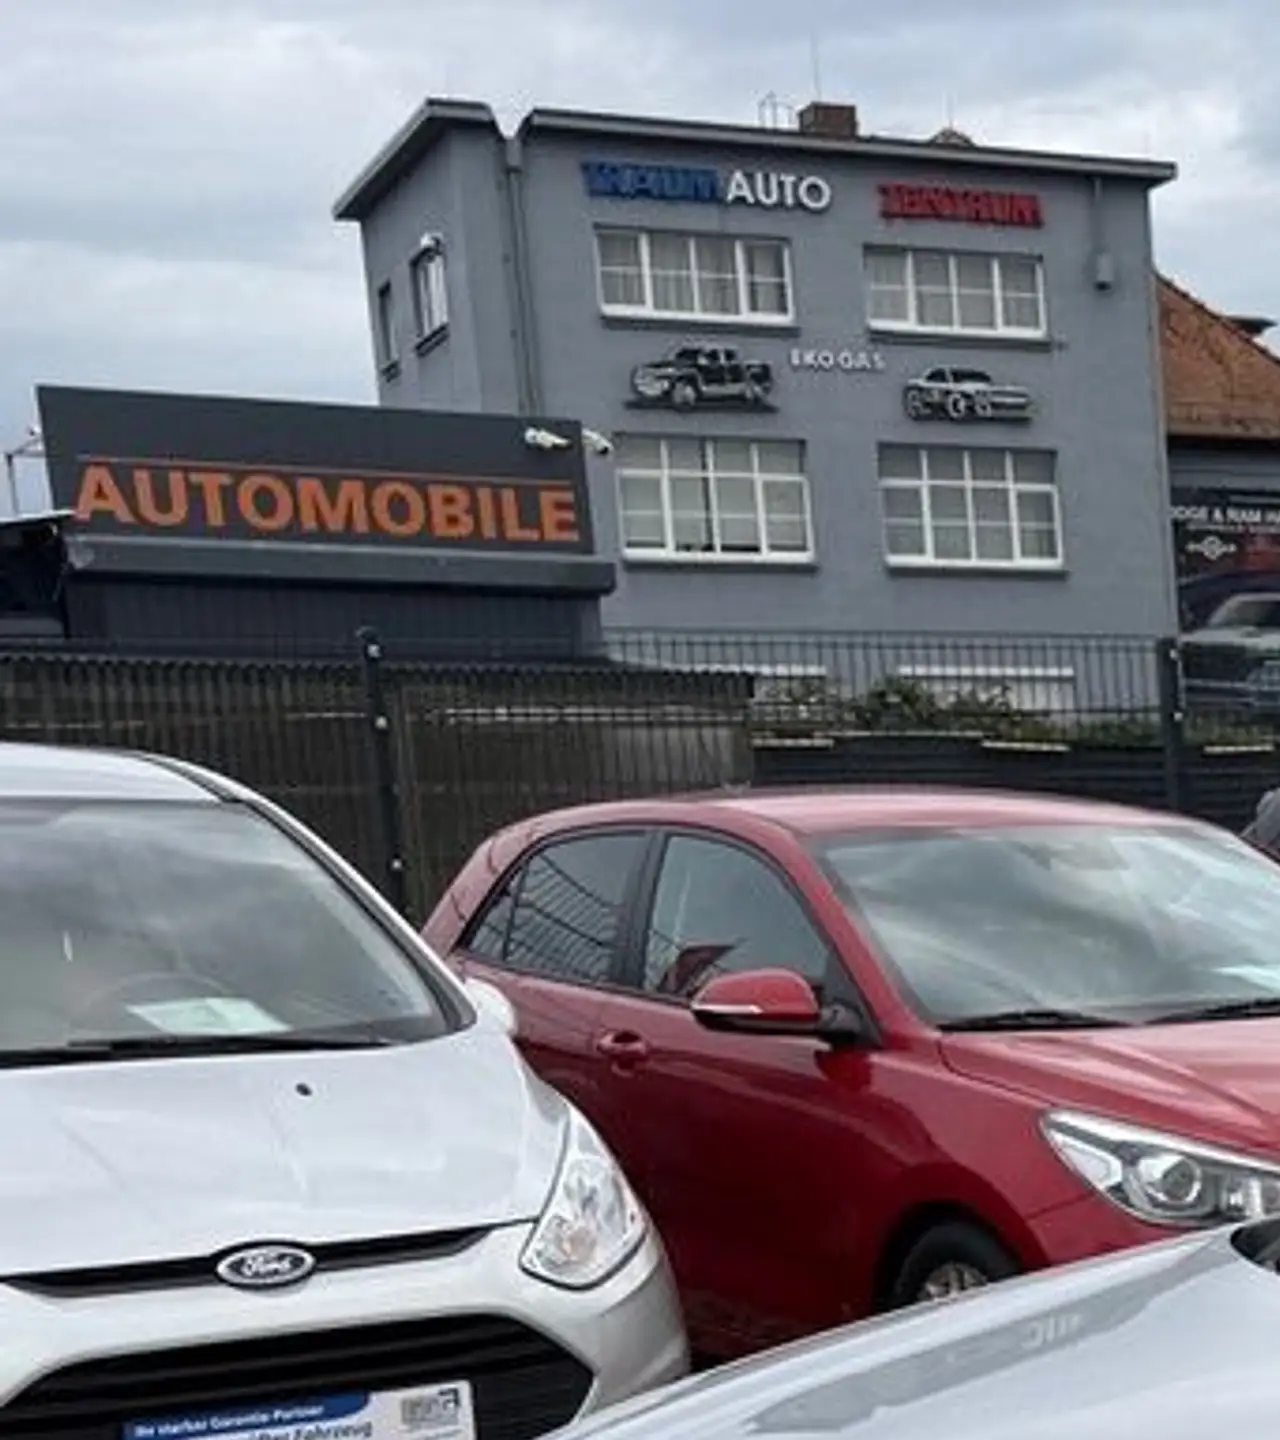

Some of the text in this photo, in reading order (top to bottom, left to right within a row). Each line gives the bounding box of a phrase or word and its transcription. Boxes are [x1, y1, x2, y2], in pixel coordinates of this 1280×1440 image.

[727, 170, 832, 210] AUTO
[74, 464, 581, 542] AUTOMOBILE
[240, 1253, 295, 1278] Ford
